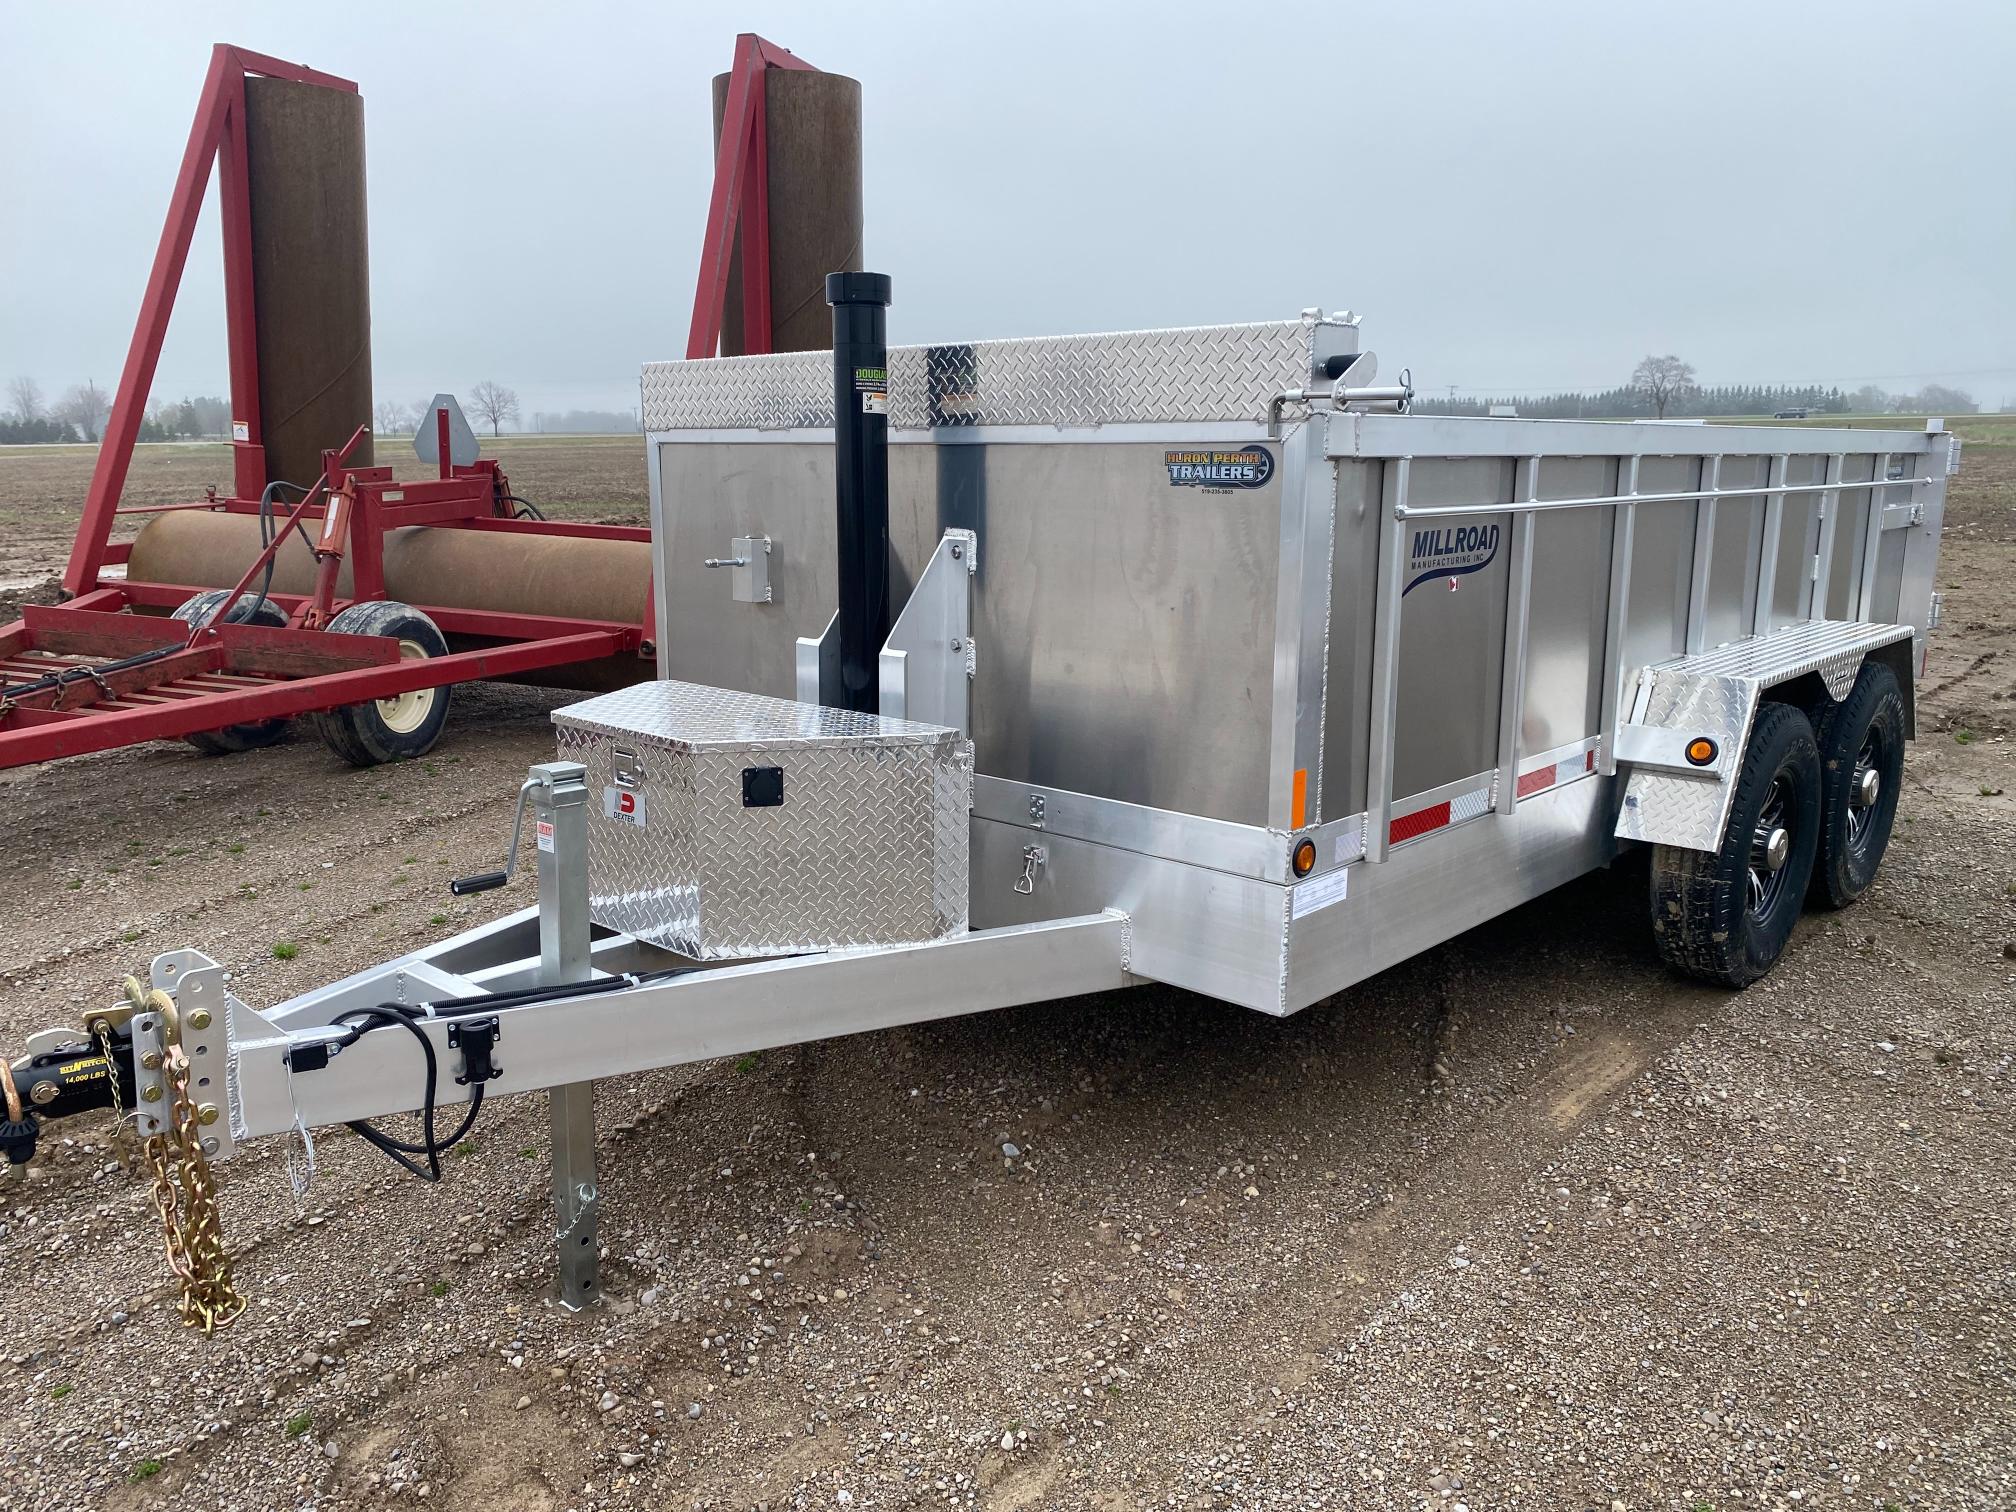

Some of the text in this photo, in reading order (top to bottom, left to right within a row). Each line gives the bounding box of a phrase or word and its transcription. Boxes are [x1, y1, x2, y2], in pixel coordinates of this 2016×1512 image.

[1167, 452, 1260, 464] HURON PERTH
[1170, 465, 1254, 479] TRAILERS
[1412, 525, 1499, 559] MILLROAD
[1411, 553, 1484, 570] MANUFACTURING INC
[613, 811, 636, 824] DEXTER
[65, 1070, 106, 1084] 14,000 LBS
